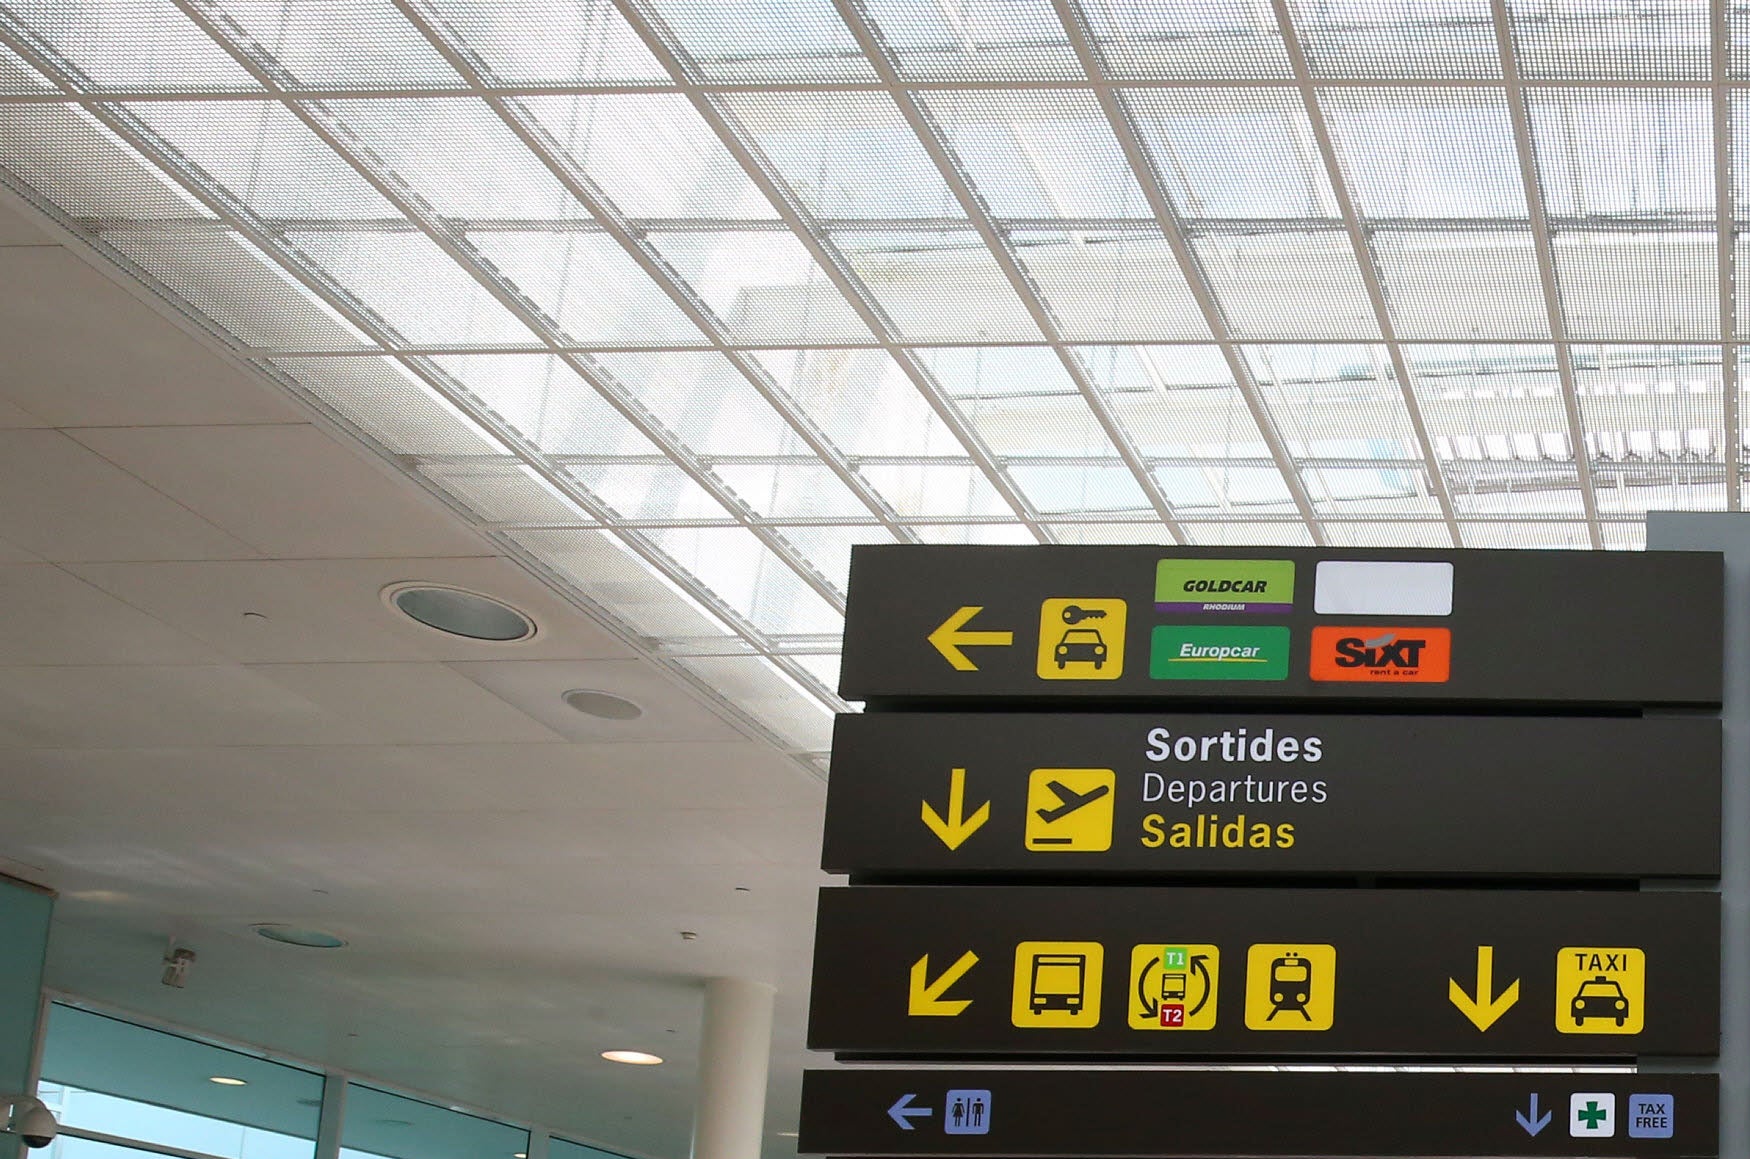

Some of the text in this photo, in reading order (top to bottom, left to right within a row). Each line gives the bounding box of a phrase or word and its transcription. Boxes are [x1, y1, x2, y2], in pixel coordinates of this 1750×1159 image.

[1183, 579, 1267, 593] GOLDCAR
[1203, 603, 1245, 611] RHODIUM
[1179, 643, 1260, 661] Europcar
[1145, 727, 1323, 762] Sortides
[1142, 772, 1328, 808] Departures
[1140, 813, 1295, 848] Salidas
[1167, 952, 1184, 965] T1
[1575, 953, 1627, 972] TAXI
[1162, 1009, 1182, 1022] T2
[1638, 1103, 1665, 1115] TAX
[1636, 1117, 1668, 1128] FREE
